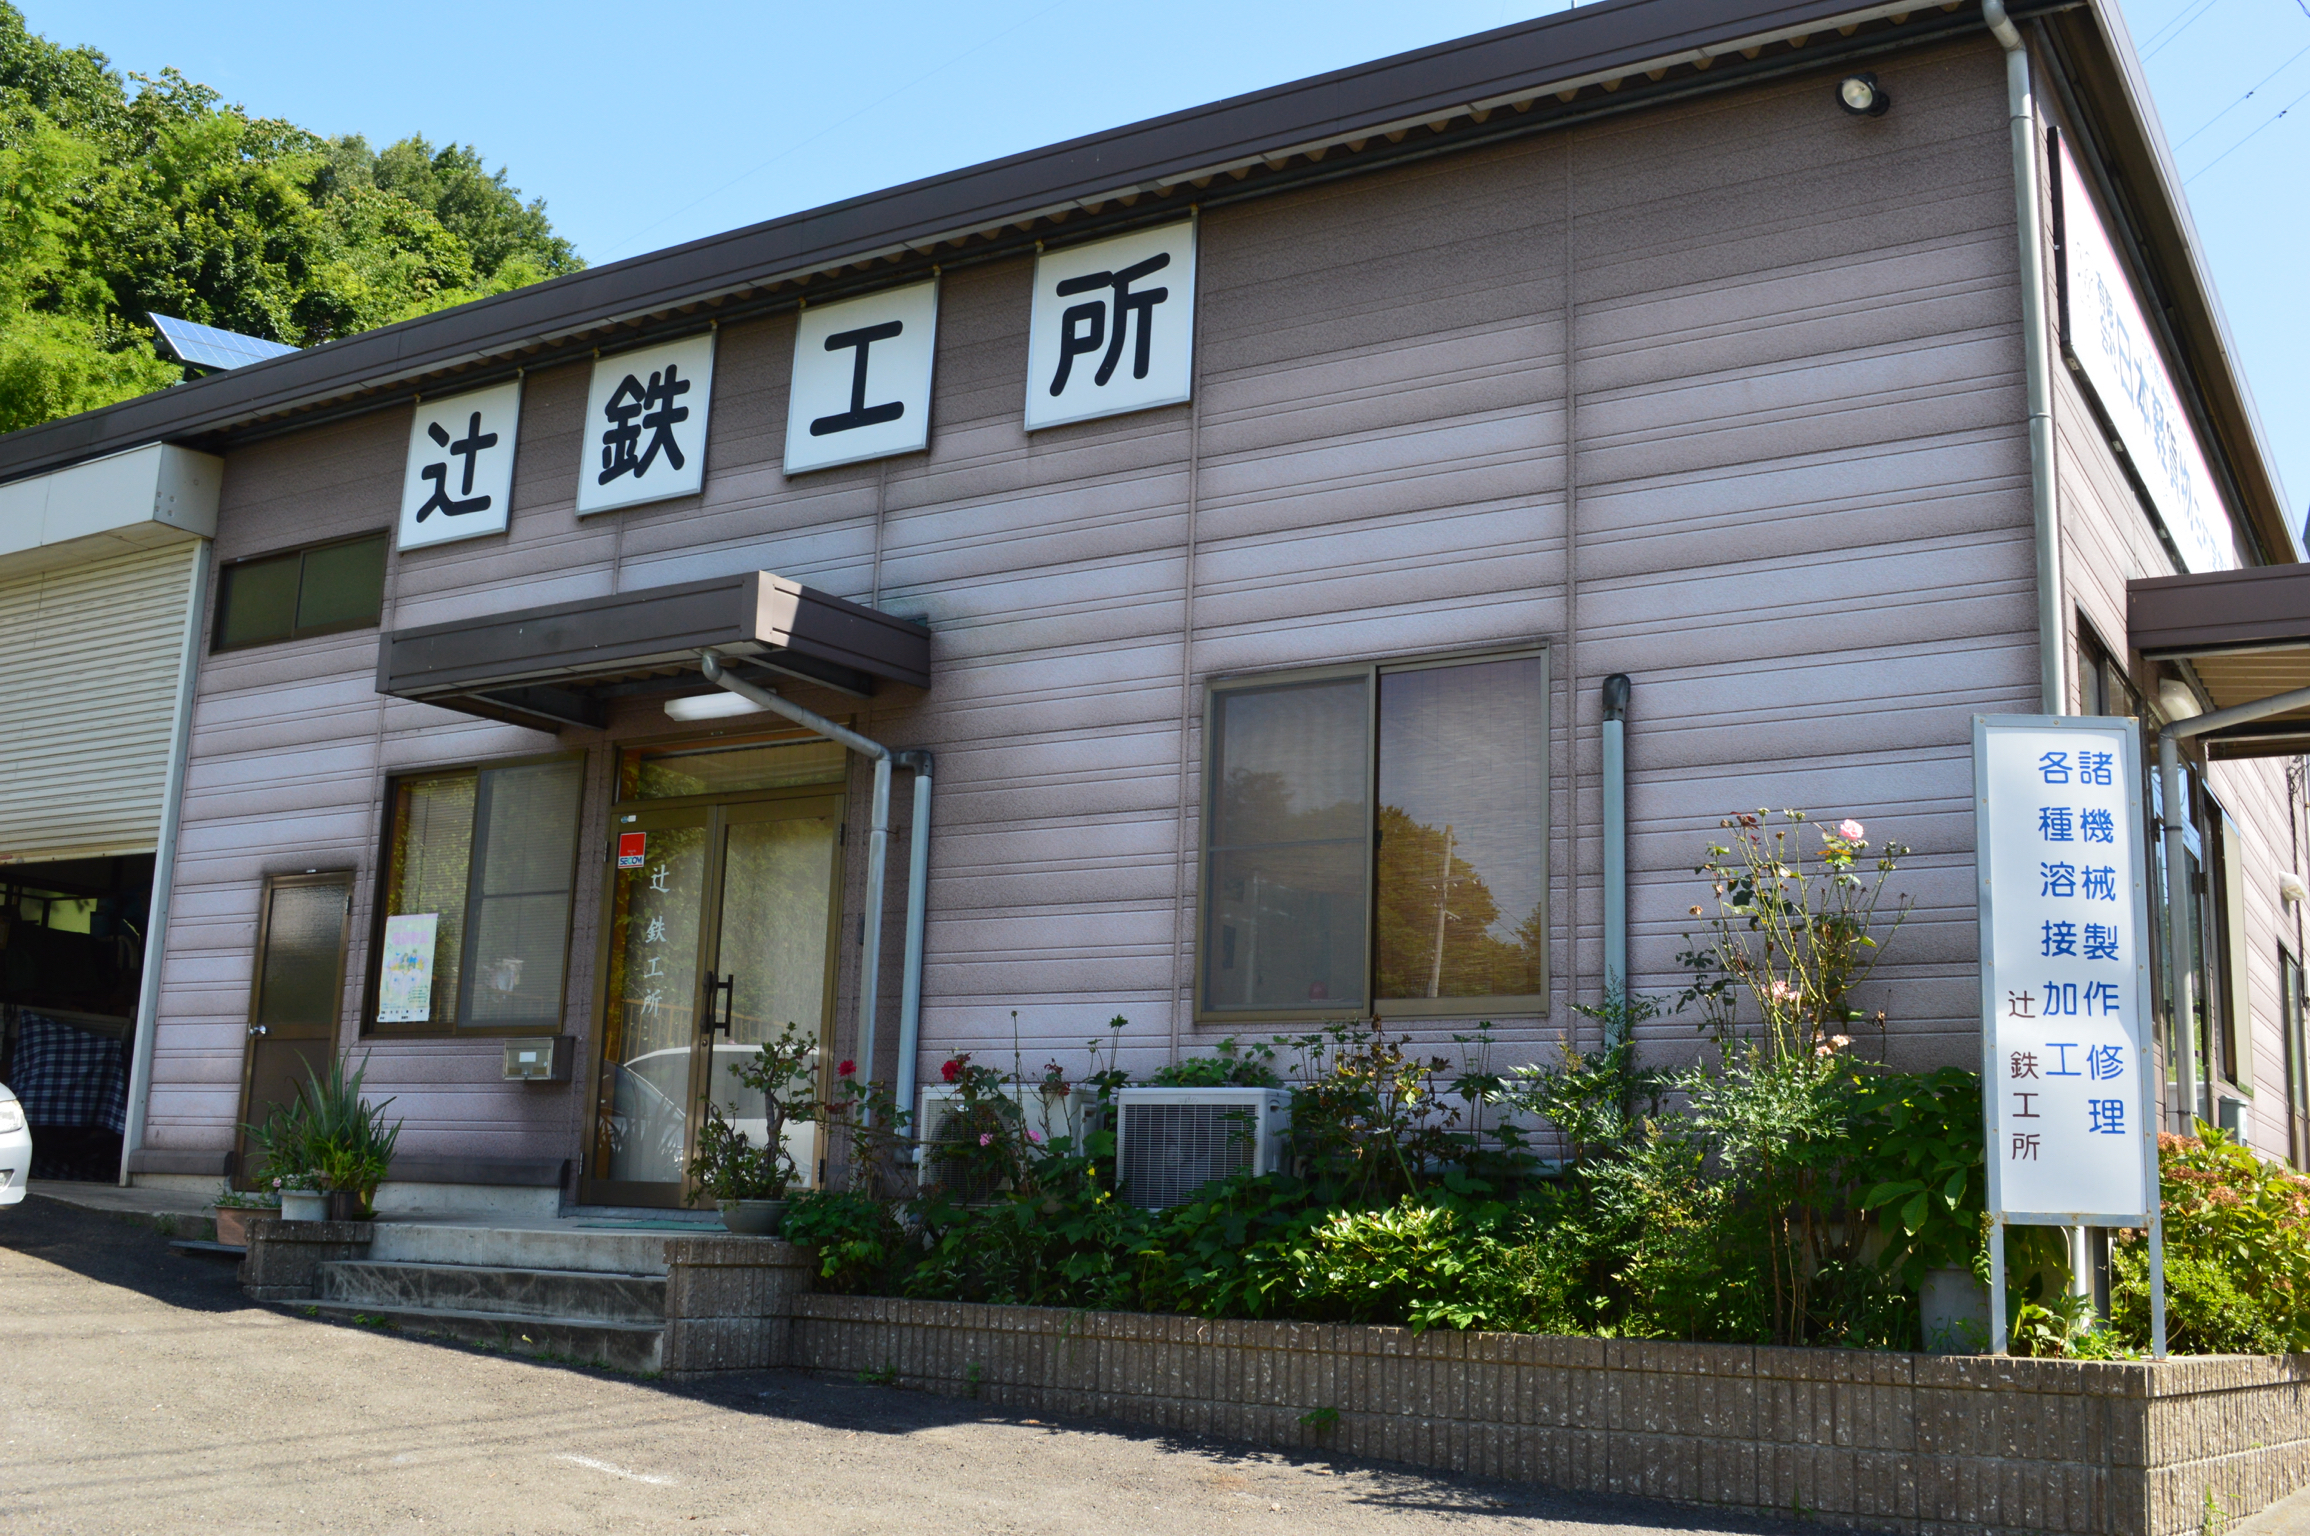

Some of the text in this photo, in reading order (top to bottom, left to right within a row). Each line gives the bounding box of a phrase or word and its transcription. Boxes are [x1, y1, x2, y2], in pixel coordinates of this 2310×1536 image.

[417, 252, 1171, 523] 辻鉄工所
[620, 856, 642, 866] SECOM
[640, 863, 671, 1018] 辻鉄工所
[2038, 751, 2082, 1077] 各種溶接加工
[2078, 750, 2126, 1136] 諸機械製作修理
[2008, 990, 2041, 1161] 辻鉄工所
